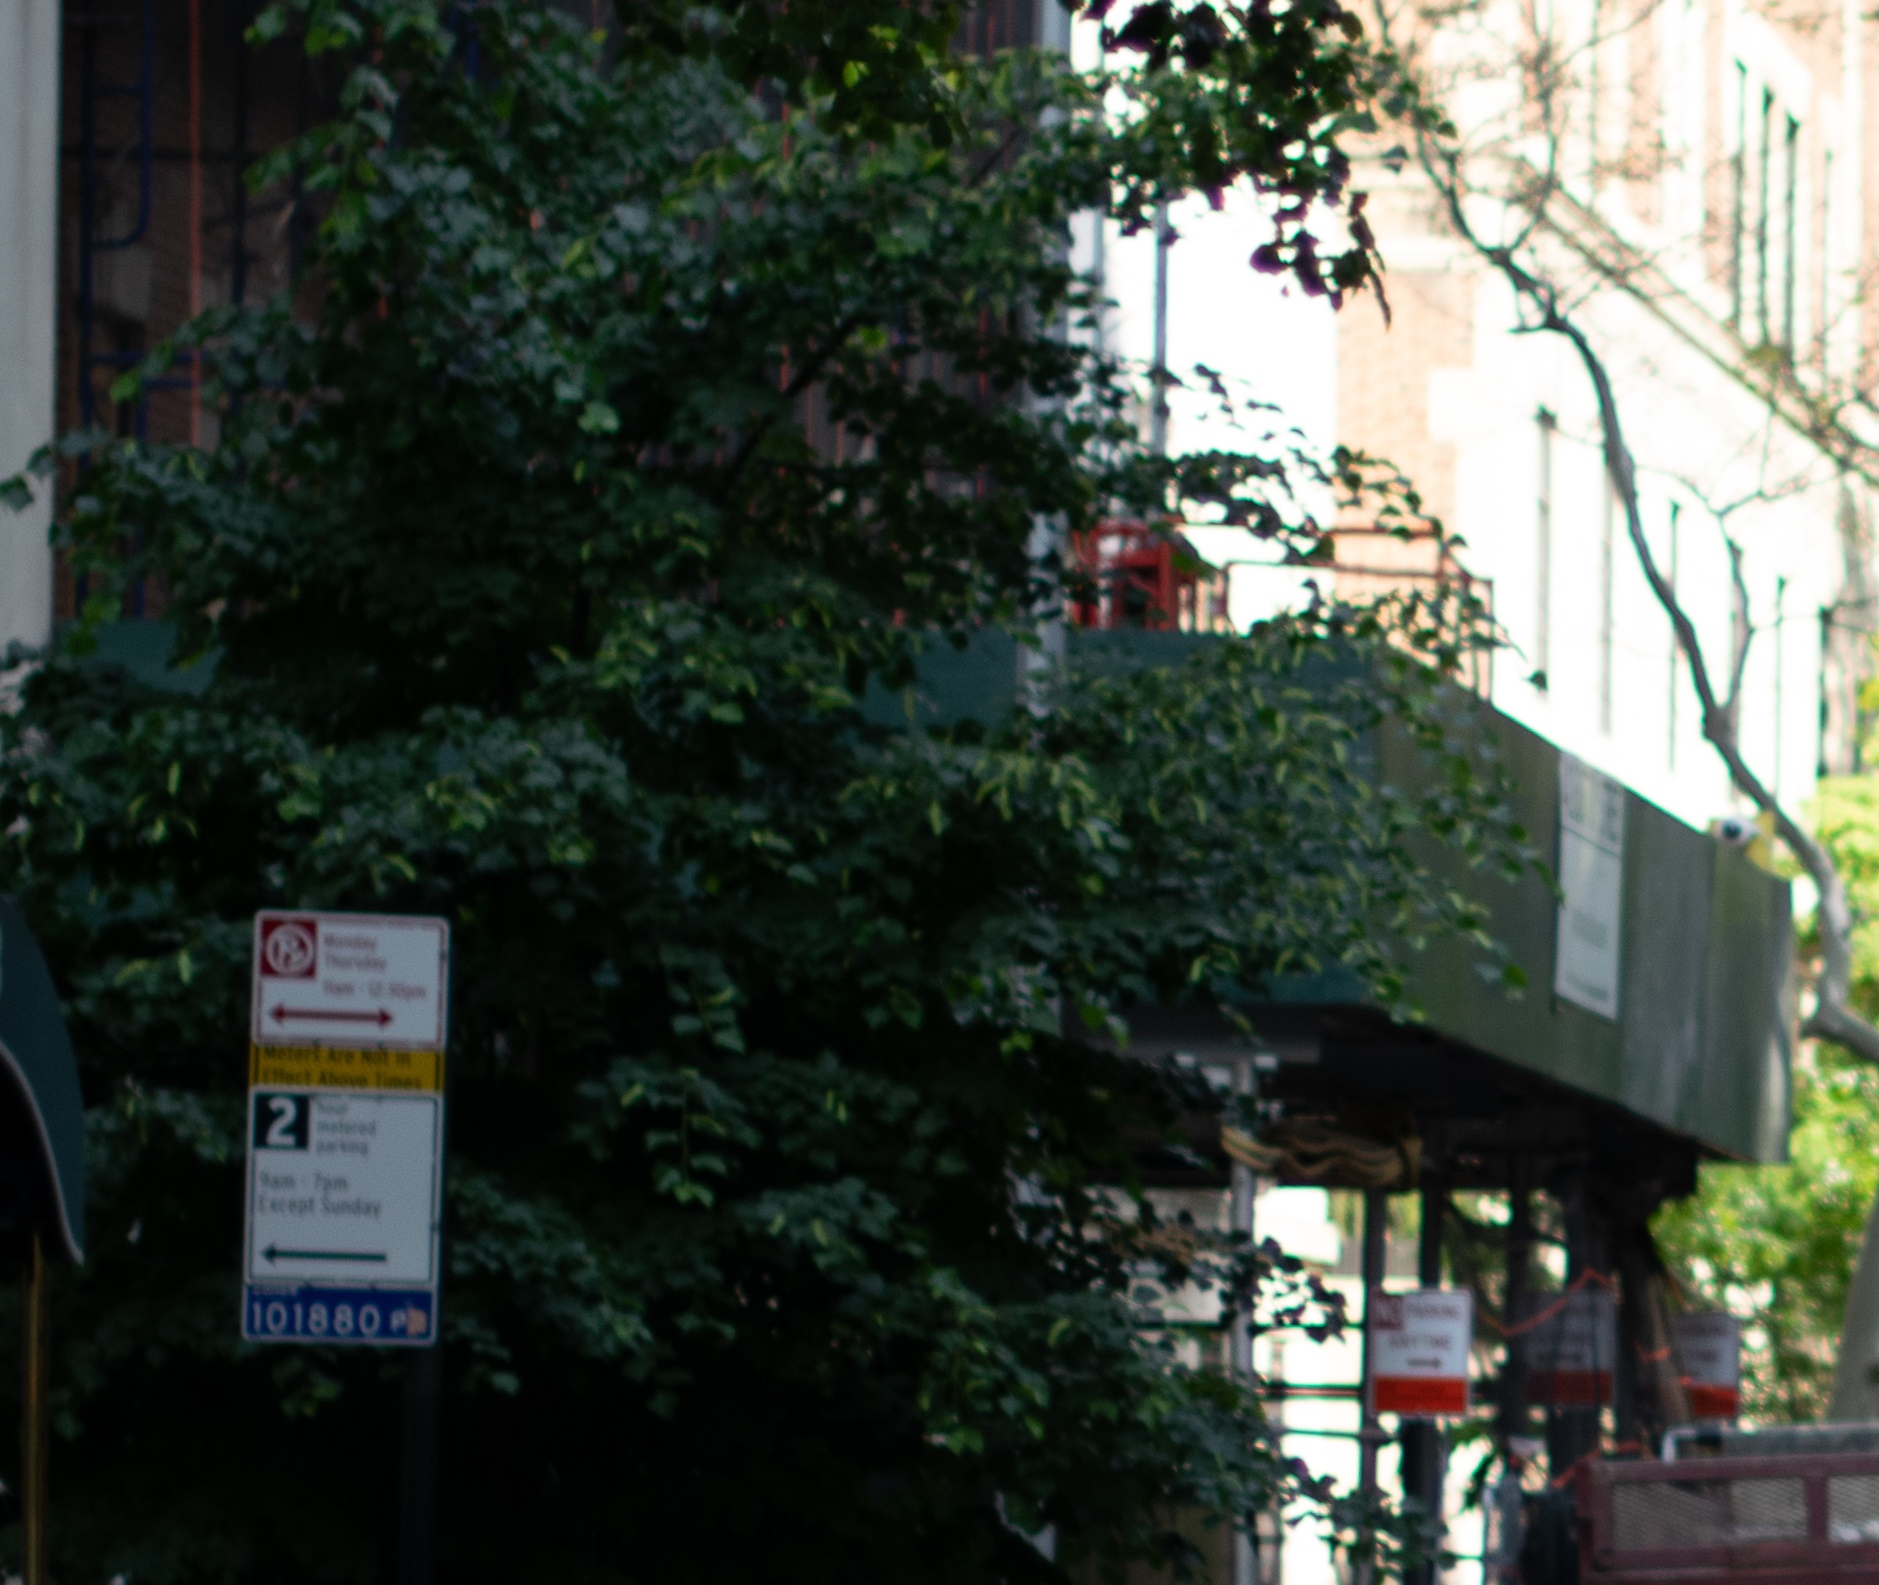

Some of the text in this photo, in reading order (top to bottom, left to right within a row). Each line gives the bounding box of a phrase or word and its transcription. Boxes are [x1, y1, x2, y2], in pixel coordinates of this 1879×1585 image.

[323, 934, 378, 953] Monday
[323, 953, 388, 973] Thursday
[328, 1047, 356, 1065] Are
[361, 1048, 389, 1066] Not
[318, 1071, 368, 1087] Above
[376, 1072, 422, 1088] Times
[265, 1097, 298, 1147] 2
[316, 1140, 369, 1158] parking
[313, 1174, 349, 1192] 7pm
[258, 1196, 382, 1219] Except Sunday
[252, 1302, 381, 1336] 101880
